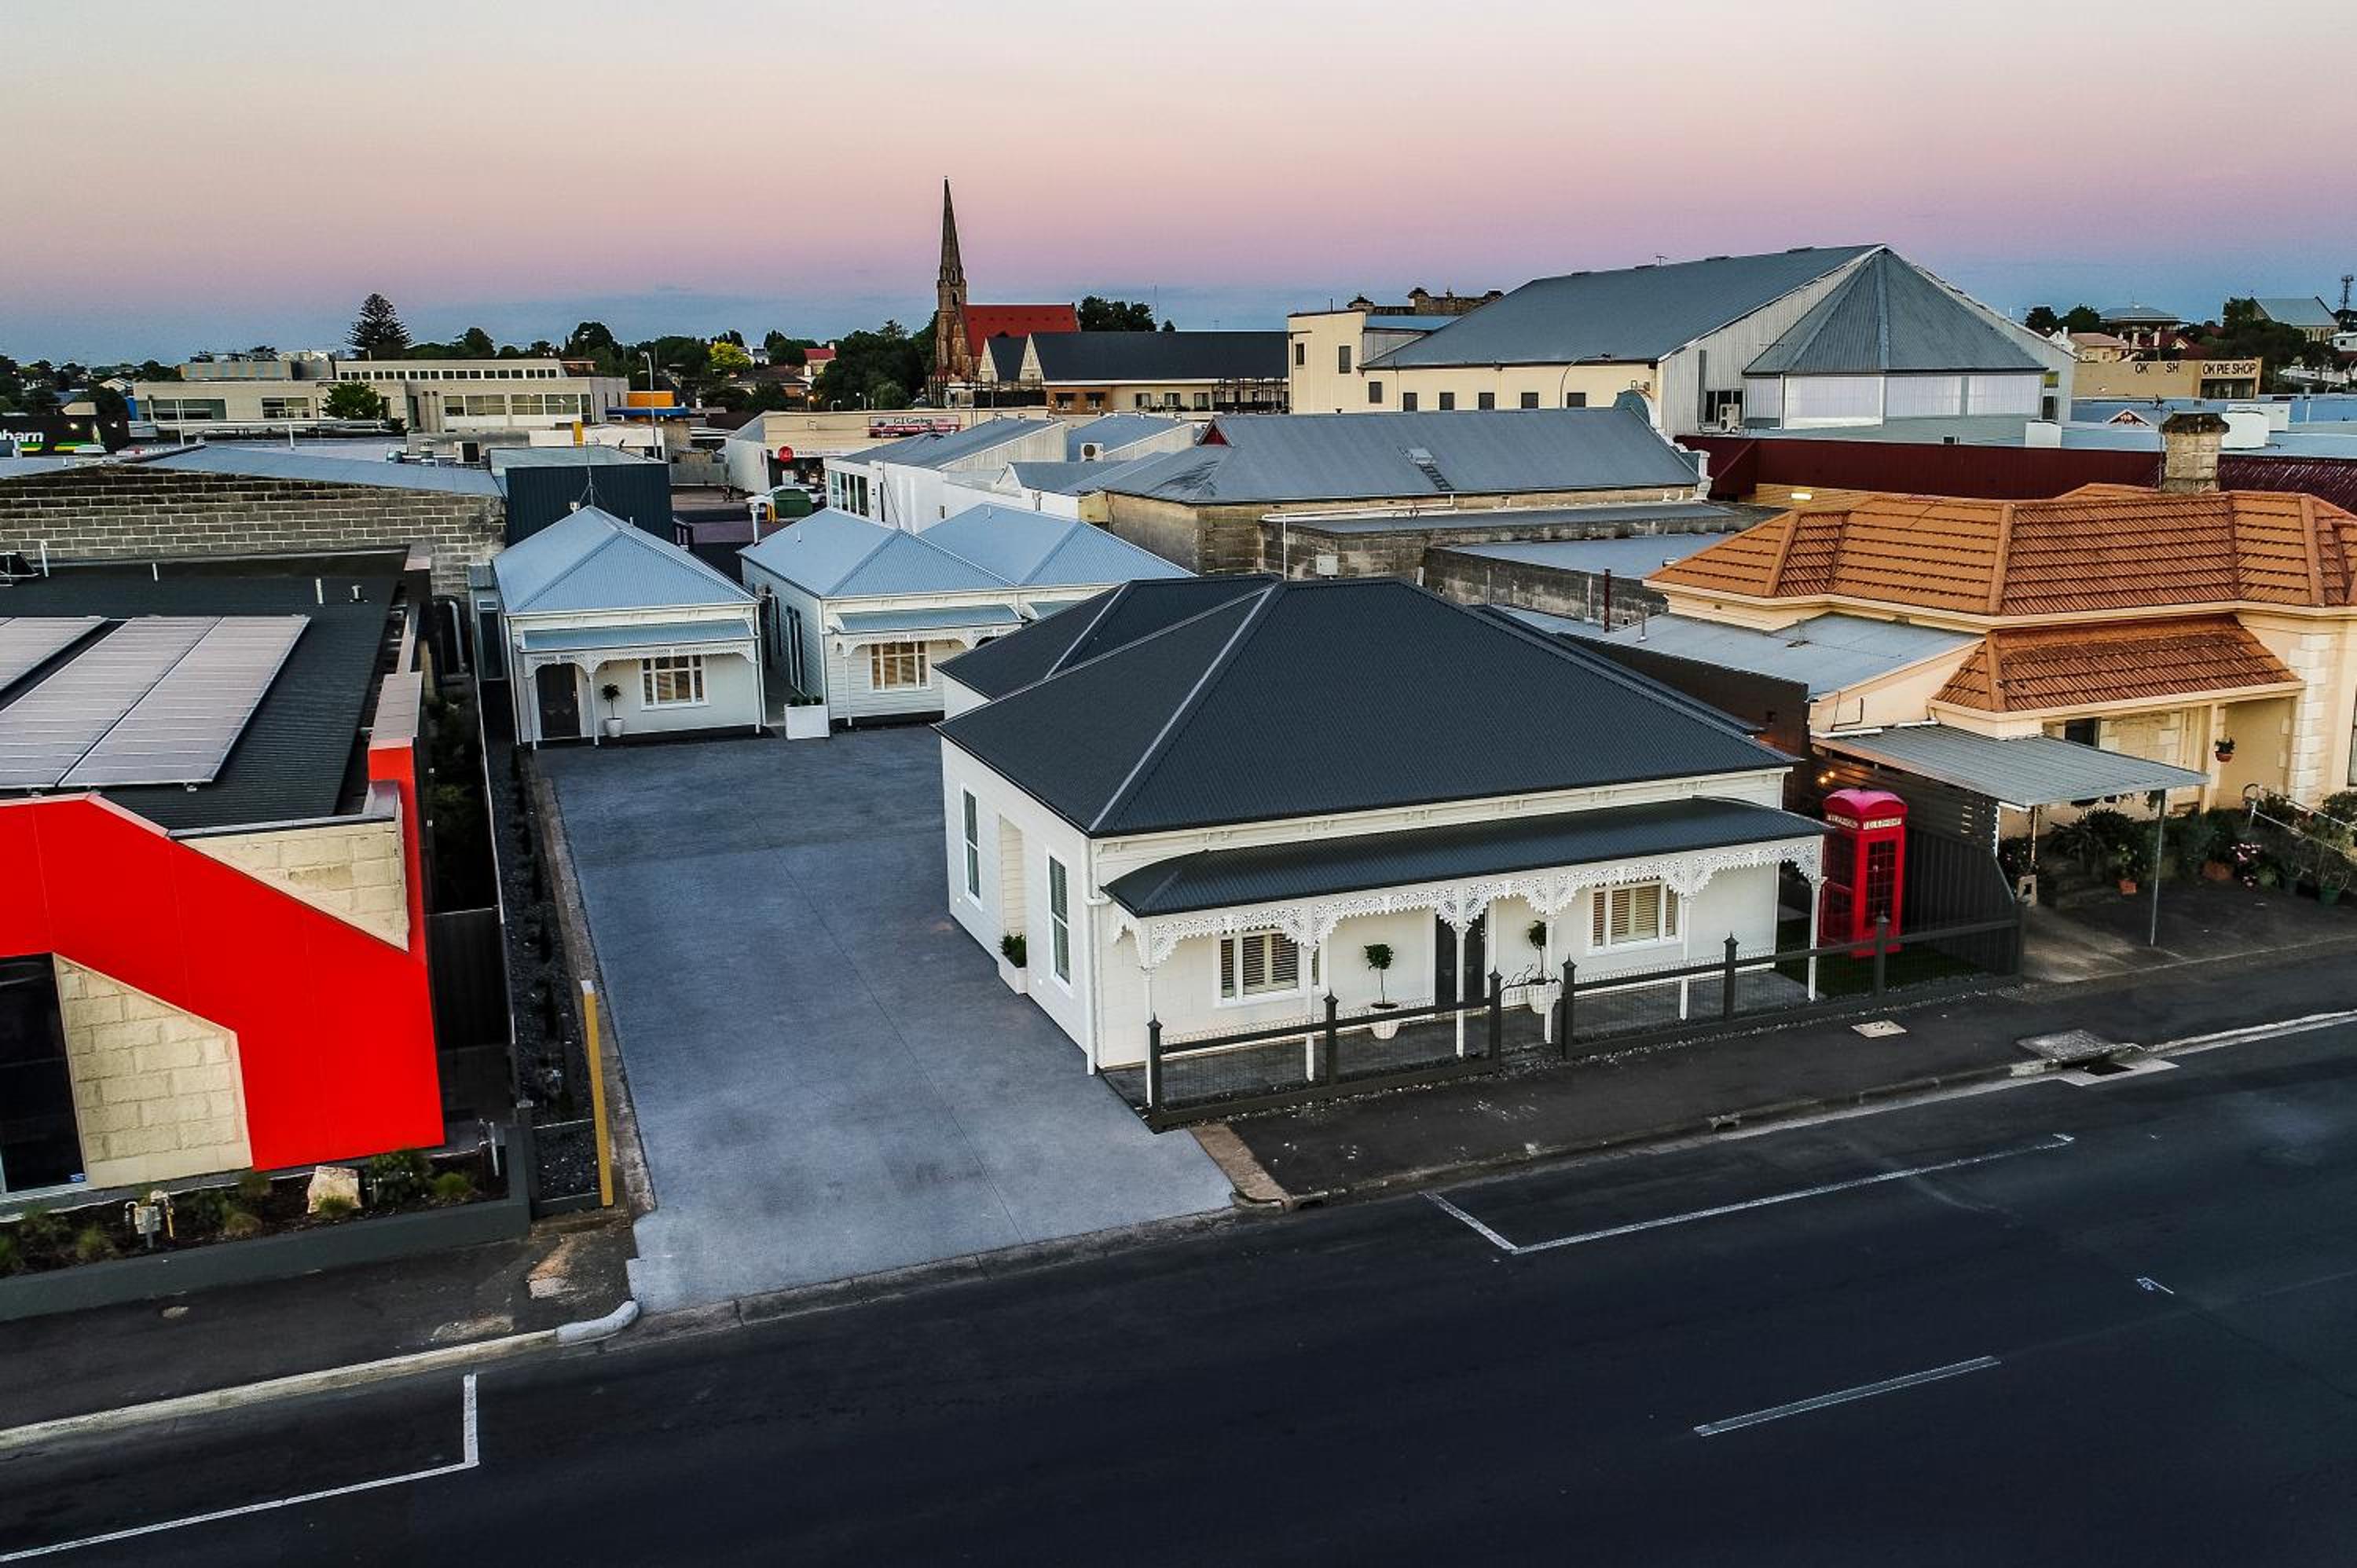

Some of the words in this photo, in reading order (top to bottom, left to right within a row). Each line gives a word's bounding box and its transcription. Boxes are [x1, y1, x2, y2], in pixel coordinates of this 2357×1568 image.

[2135, 363, 2149, 374] OK
[2167, 363, 2179, 373] SH
[2203, 364, 2215, 375] OK
[2231, 363, 2256, 375] SHOP
